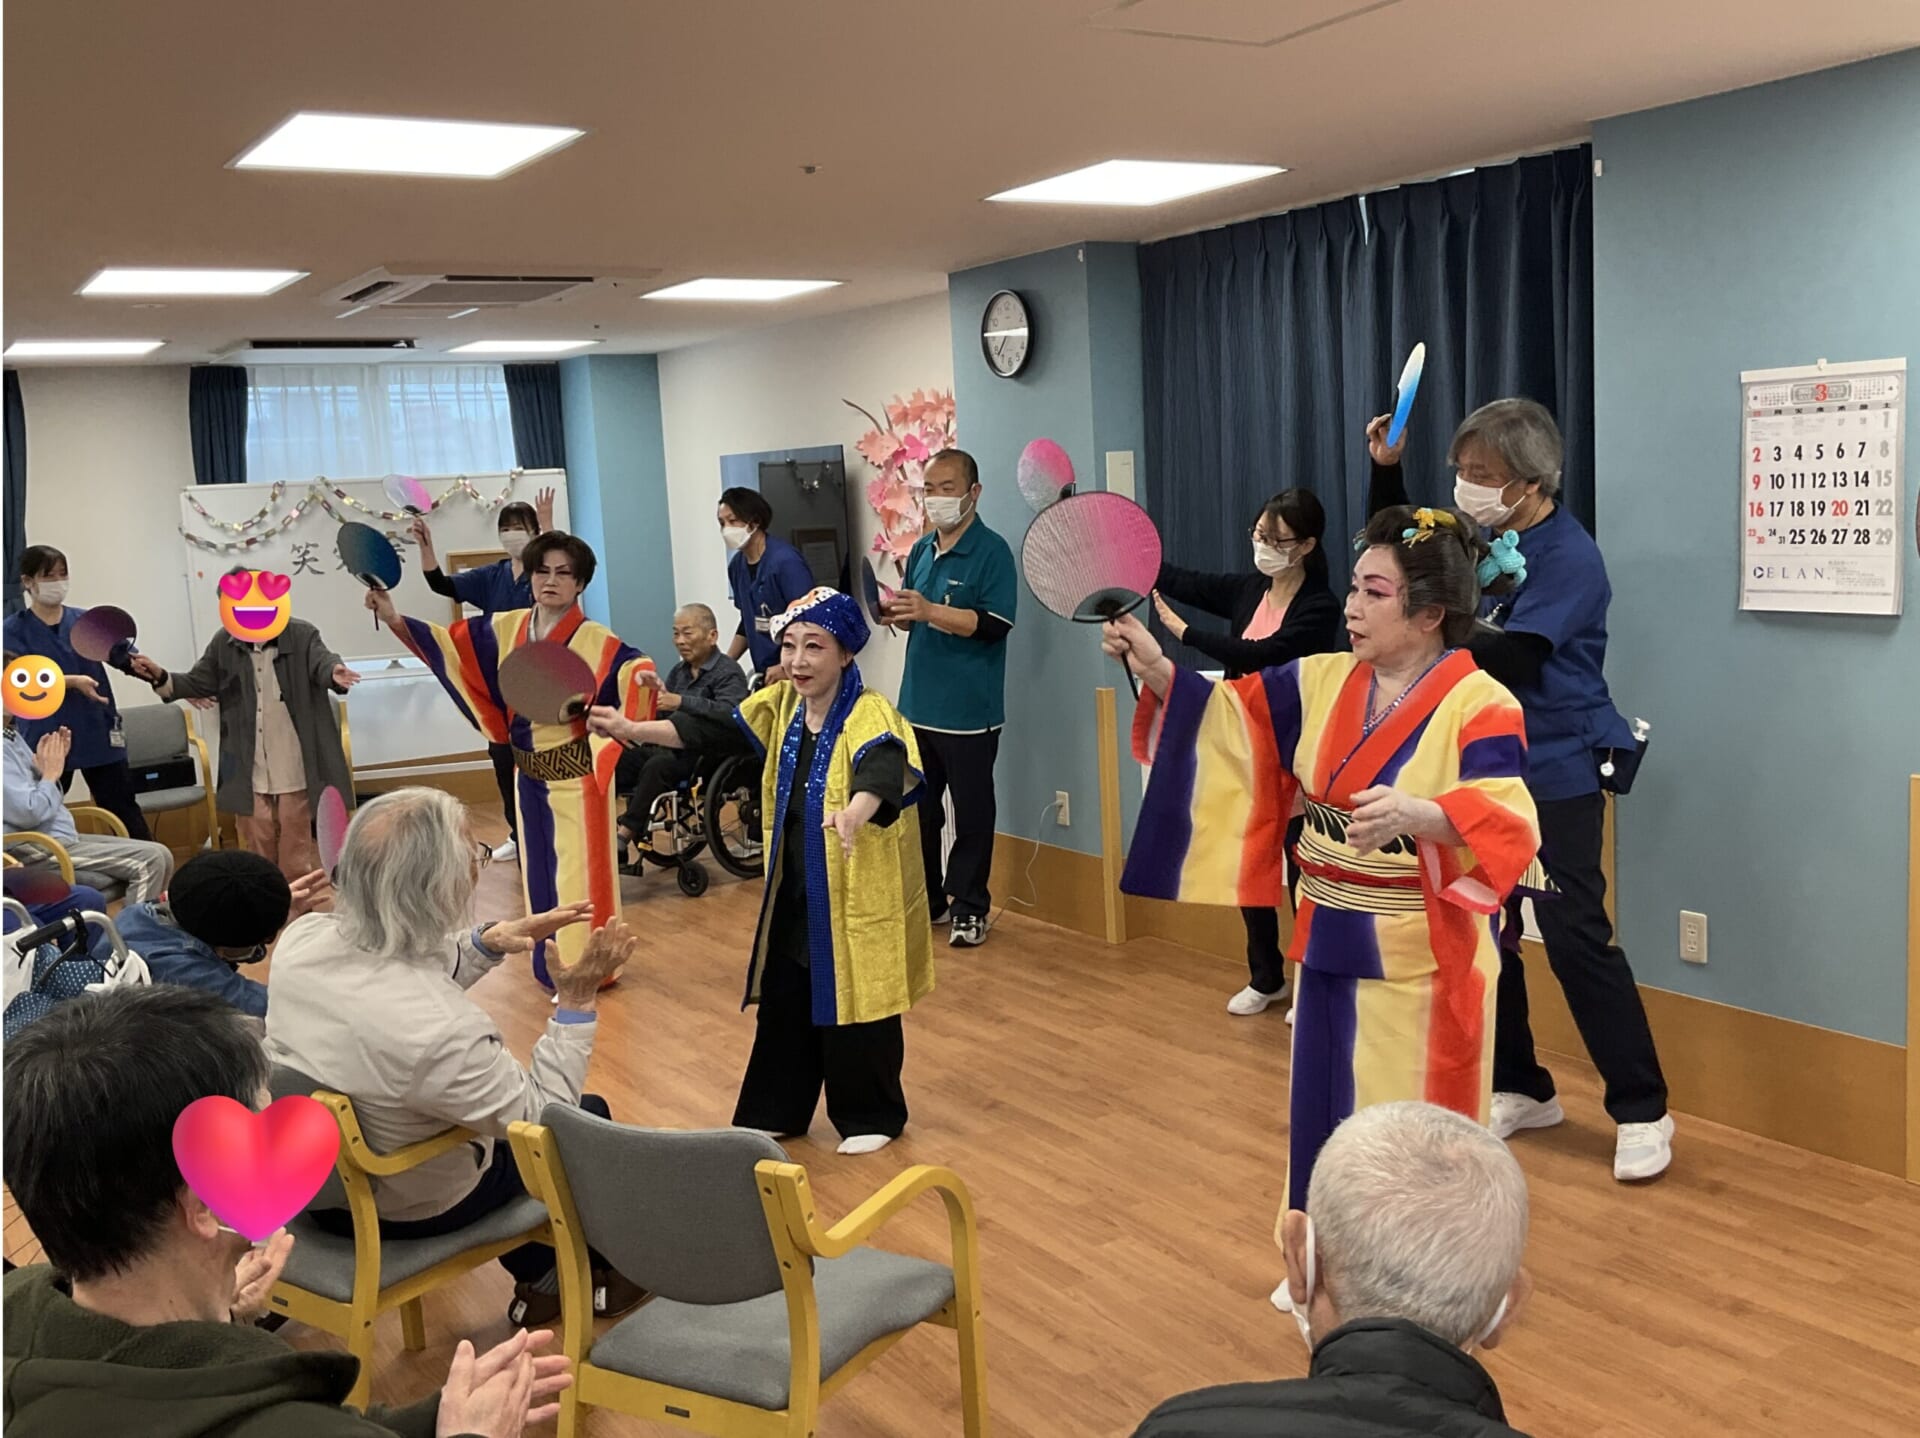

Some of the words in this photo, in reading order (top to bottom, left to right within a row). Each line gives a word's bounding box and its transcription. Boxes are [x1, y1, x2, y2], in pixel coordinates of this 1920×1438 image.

[1815, 384, 1827, 402] 3
[1882, 412, 1890, 428] 1
[1752, 447, 1761, 462] 2
[1773, 446, 1782, 462] 3
[1794, 444, 1803, 460] 4
[1815, 444, 1824, 459] 5
[1836, 443, 1845, 459] 6
[1857, 442, 1866, 458] 7
[1879, 441, 1890, 457] 8
[1752, 475, 1761, 490] 9
[1770, 474, 1785, 489] 10
[1791, 473, 1805, 489] 11
[1811, 472, 1826, 488] 12
[1832, 471, 1848, 488] 13
[1854, 470, 1870, 487] 14
[1876, 470, 1892, 487] 15
[1749, 502, 1764, 517] 16
[1770, 501, 1784, 517] 17
[1790, 501, 1805, 517] 18
[1810, 500, 1826, 516] 19
[1831, 500, 1849, 516] 20
[1855, 499, 1869, 516] 21
[1875, 499, 1893, 516] 22
[1768, 528, 1776, 537] 24
[1789, 529, 1806, 544] 25
[1810, 528, 1827, 544] 26
[1831, 529, 1848, 545] 27
[1853, 528, 1871, 545] 28
[1875, 528, 1893, 545] 29
[1778, 536, 1786, 544] 31
[1767, 567, 1824, 580] ELAN
